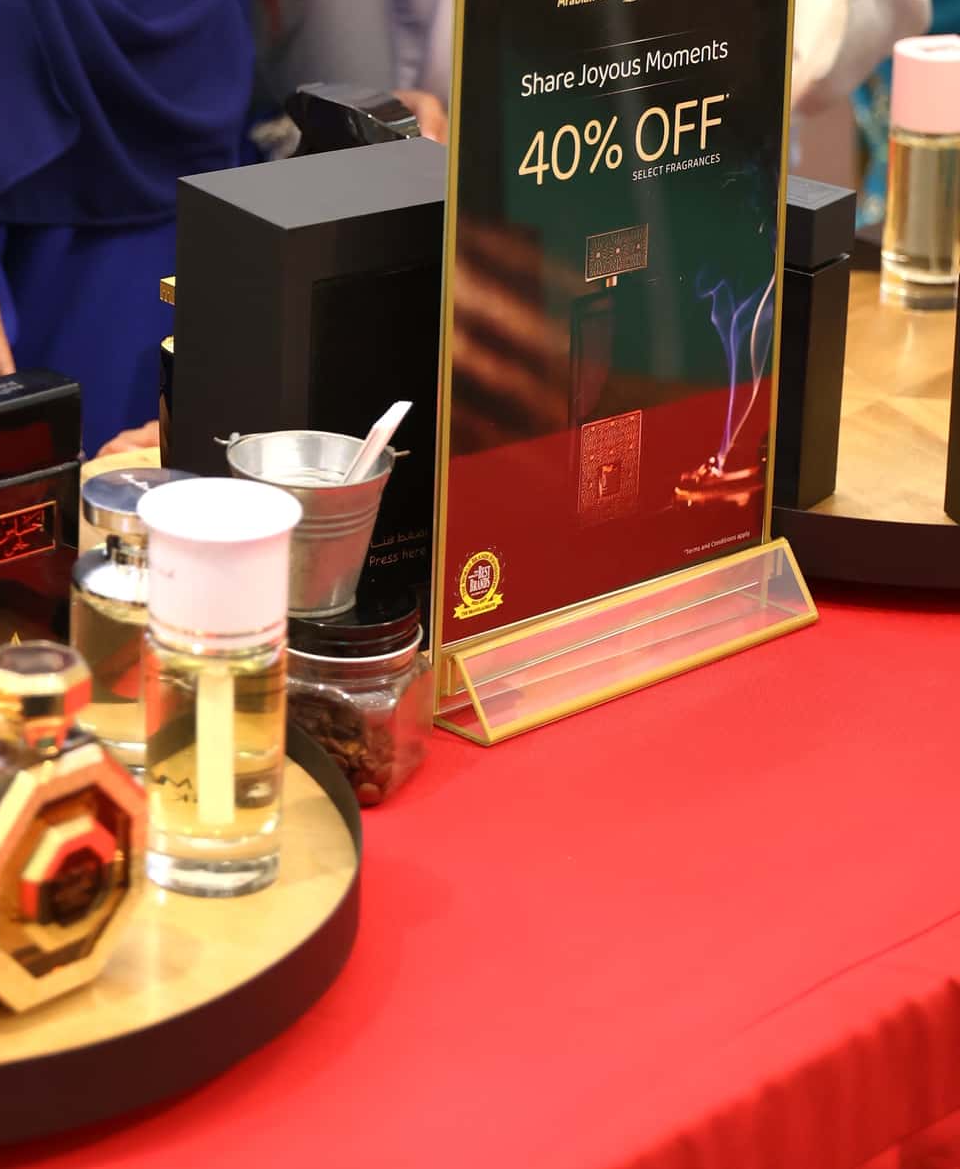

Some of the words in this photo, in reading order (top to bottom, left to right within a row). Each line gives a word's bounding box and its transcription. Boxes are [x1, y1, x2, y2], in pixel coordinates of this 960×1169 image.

[520, 68, 575, 97] Share
[578, 55, 641, 87] Joyous
[645, 39, 729, 73] Moments
[517, 114, 623, 185] 40%
[632, 164, 663, 181] SELECT
[665, 153, 721, 176] FRAGRANCES
[701, 542, 710, 551] and
[711, 534, 737, 548] Conditions
[369, 552, 400, 567] Press
[478, 565, 491, 579] BEST
[469, 577, 491, 593] BRANDS
